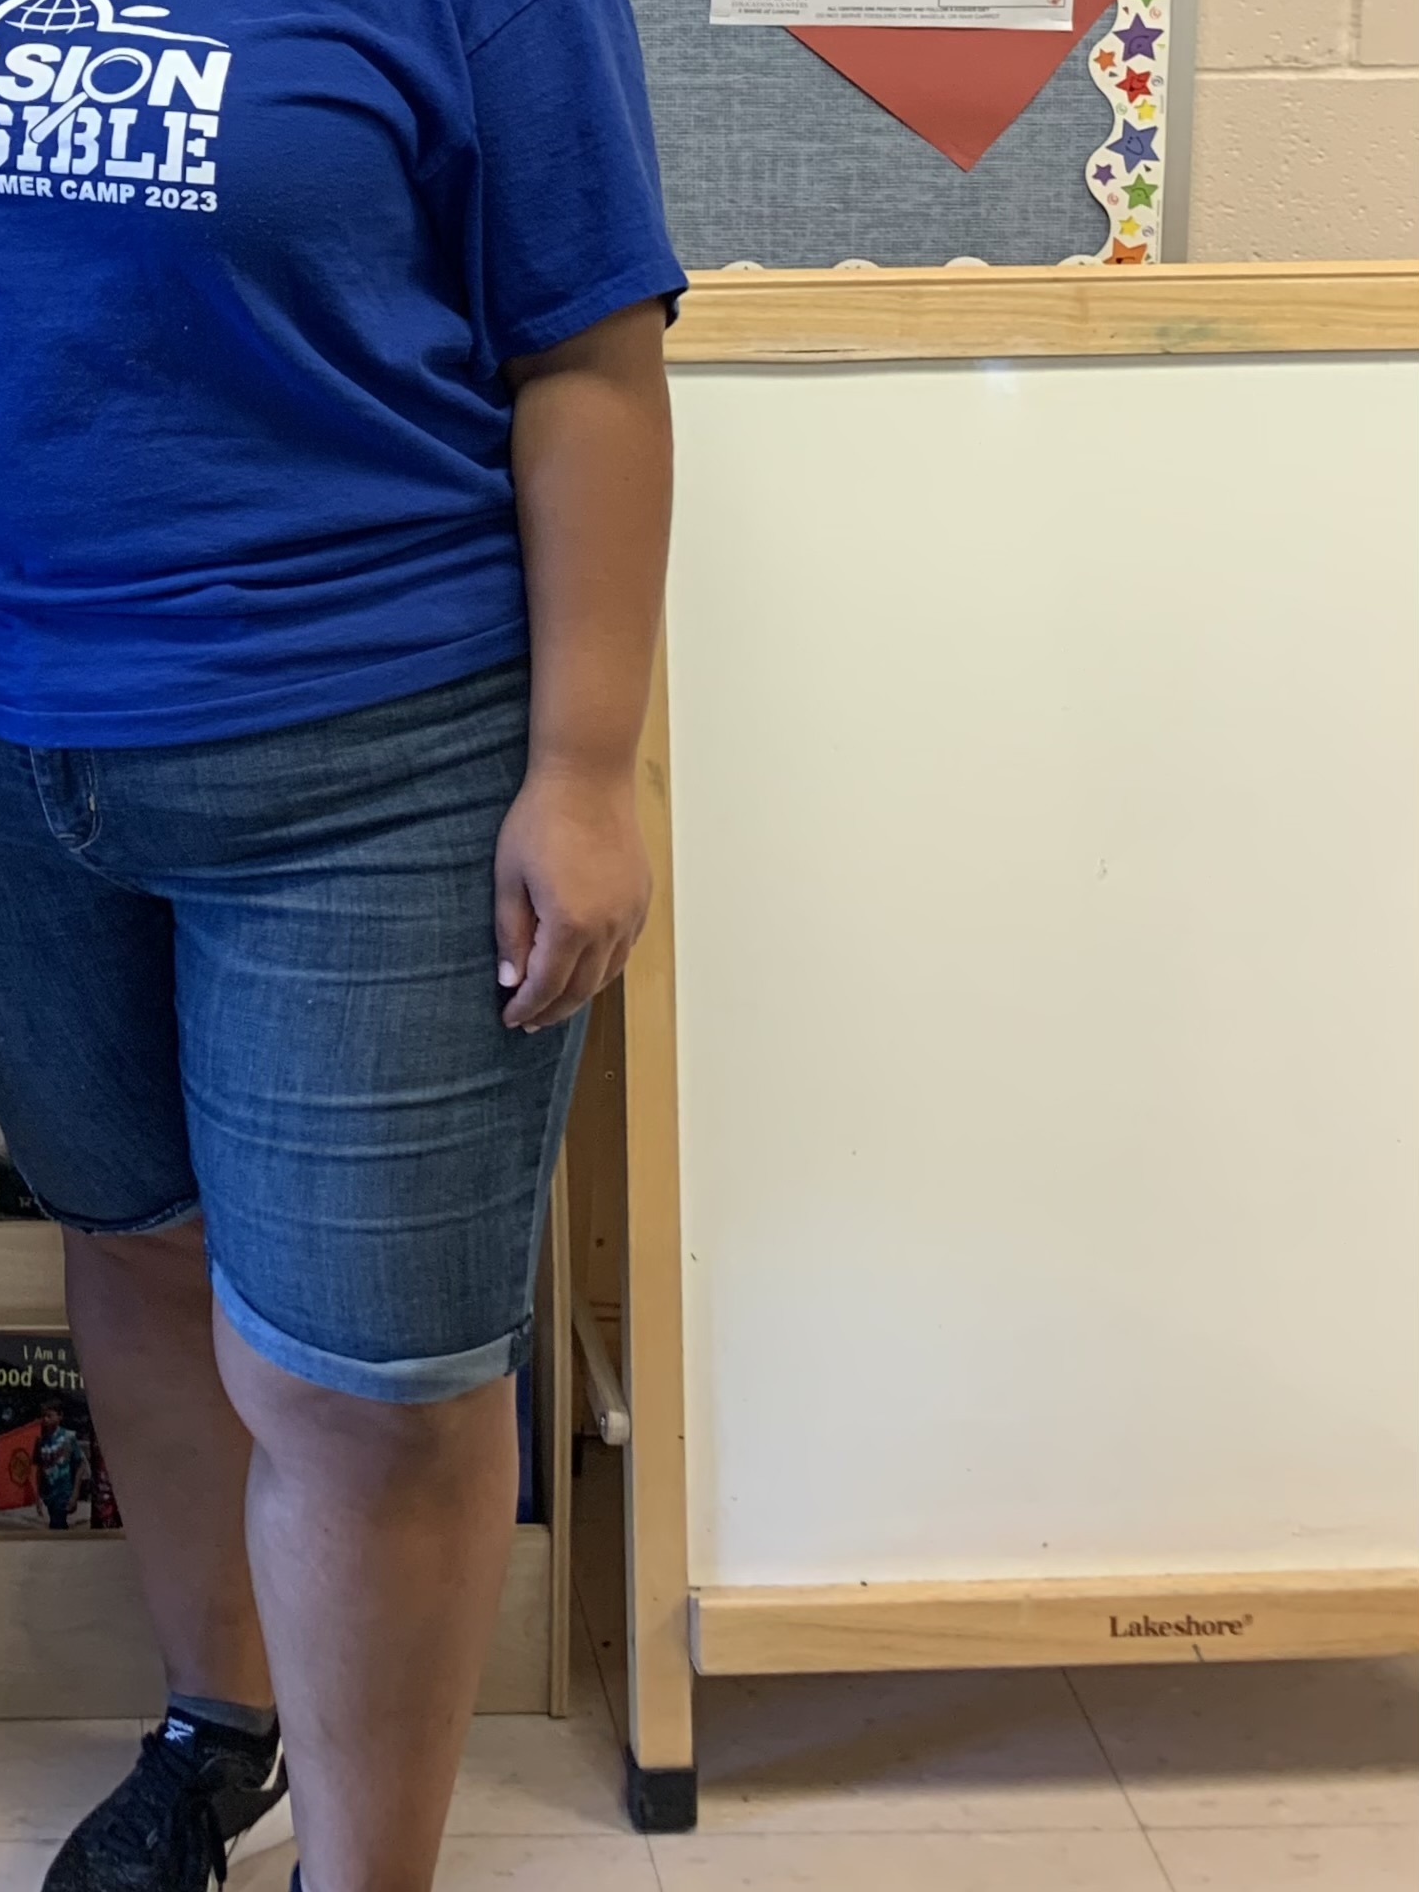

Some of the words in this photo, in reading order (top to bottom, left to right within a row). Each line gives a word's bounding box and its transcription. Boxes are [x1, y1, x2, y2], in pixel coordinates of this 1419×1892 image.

[60, 179, 136, 205] CAMP
[145, 186, 218, 213] 2023
[23, 1344, 29, 1361] I
[34, 1345, 53, 1361] Am
